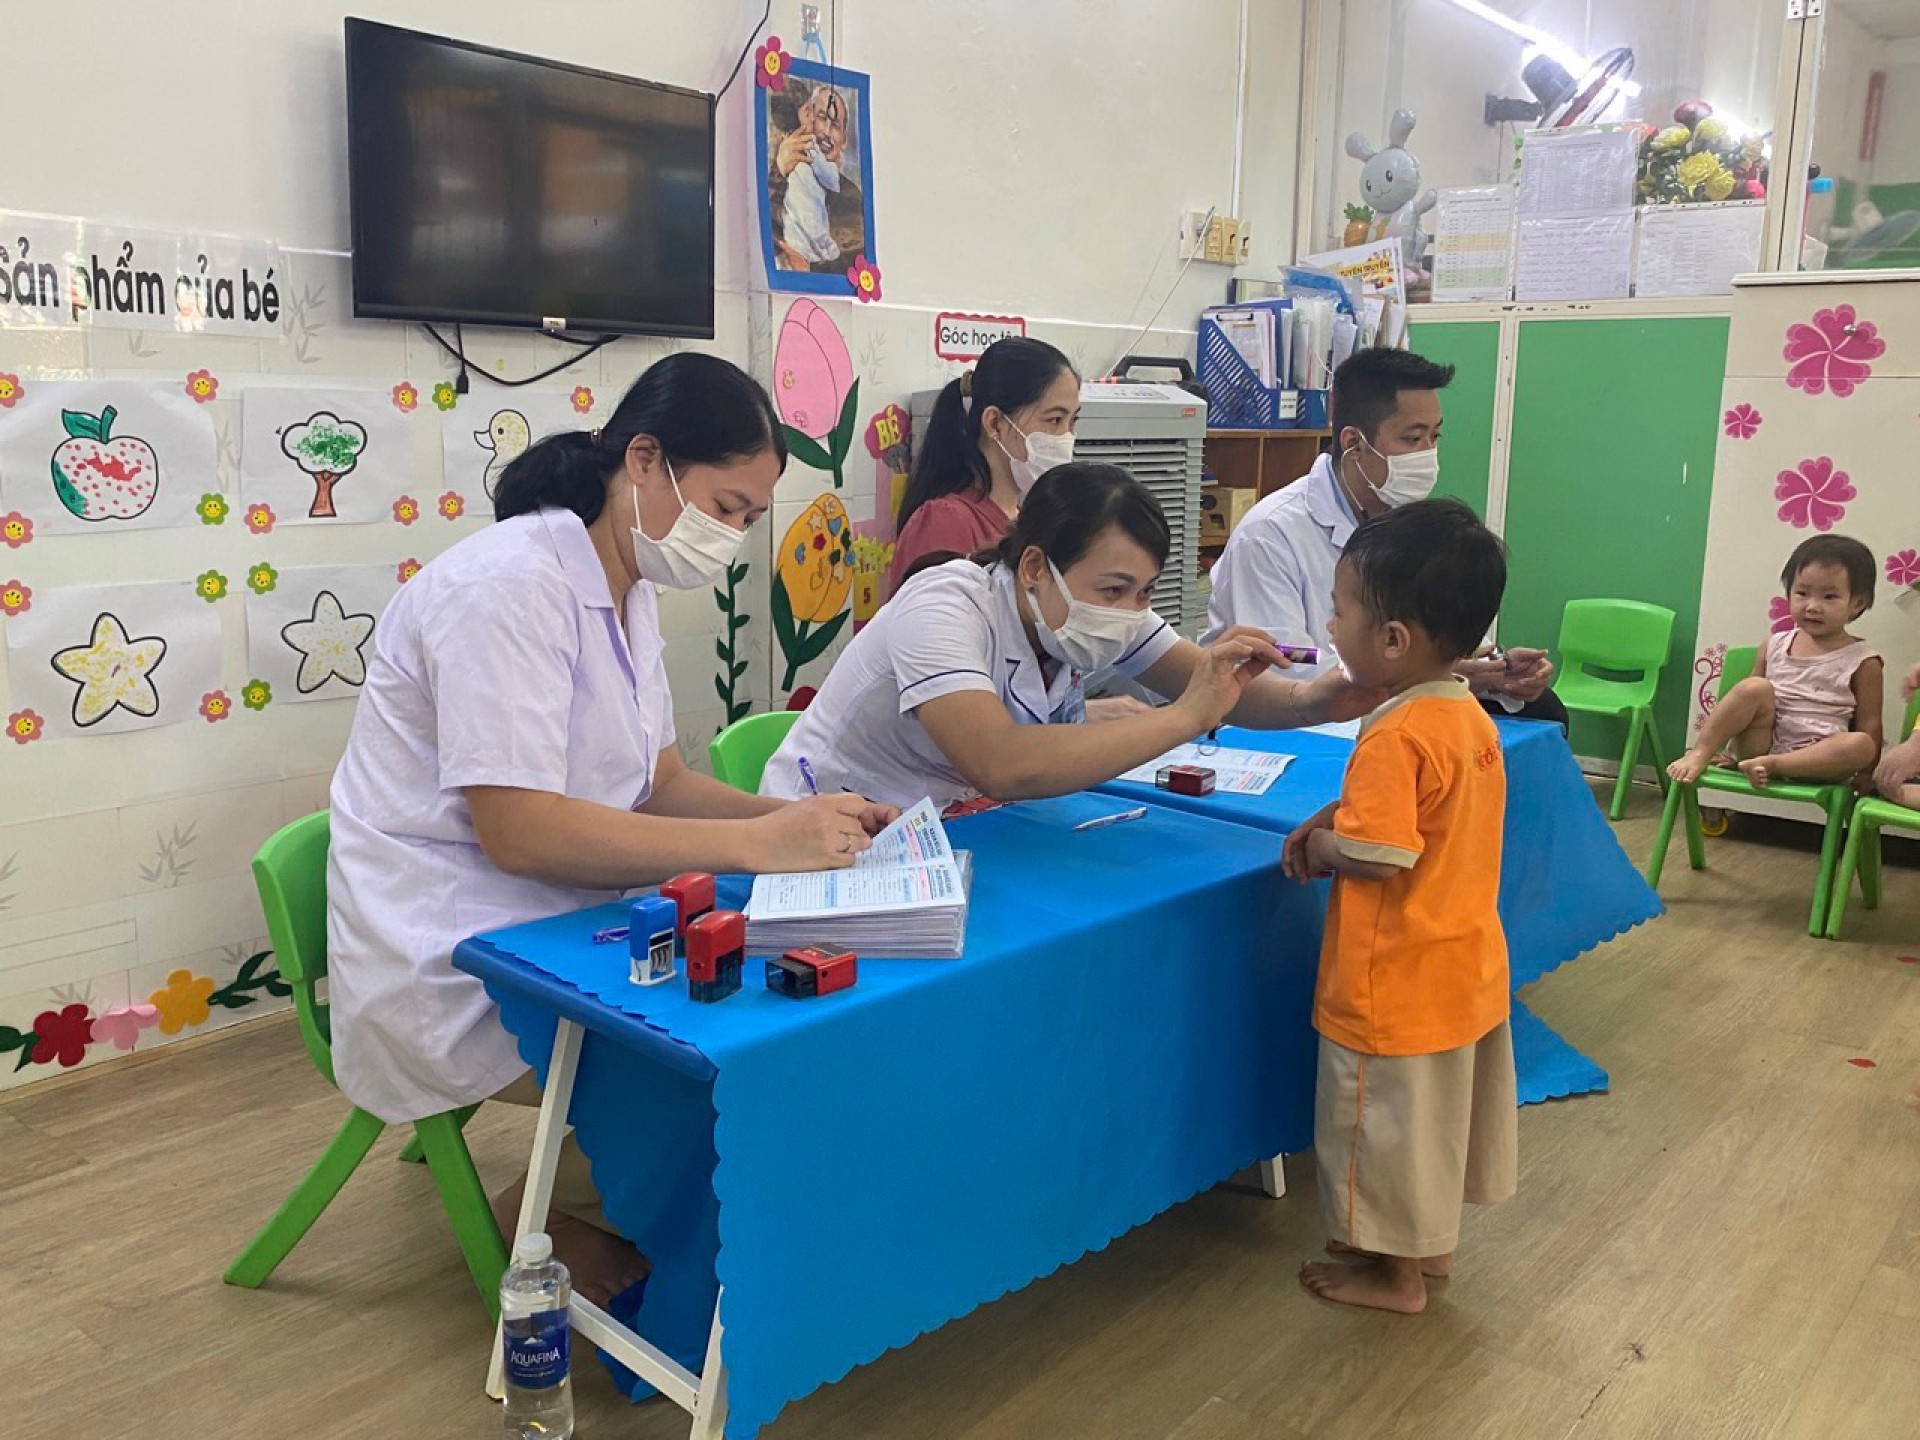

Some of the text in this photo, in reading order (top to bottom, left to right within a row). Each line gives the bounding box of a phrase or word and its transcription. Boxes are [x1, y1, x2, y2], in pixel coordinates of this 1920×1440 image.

[71, 240, 166, 322] phẩm
[173, 254, 235, 319] của
[242, 267, 280, 323] bé
[940, 326, 969, 345] Góc
[971, 328, 997, 350] học
[863, 588, 871, 604] 5
[510, 1346, 561, 1367] AQUAFINA
